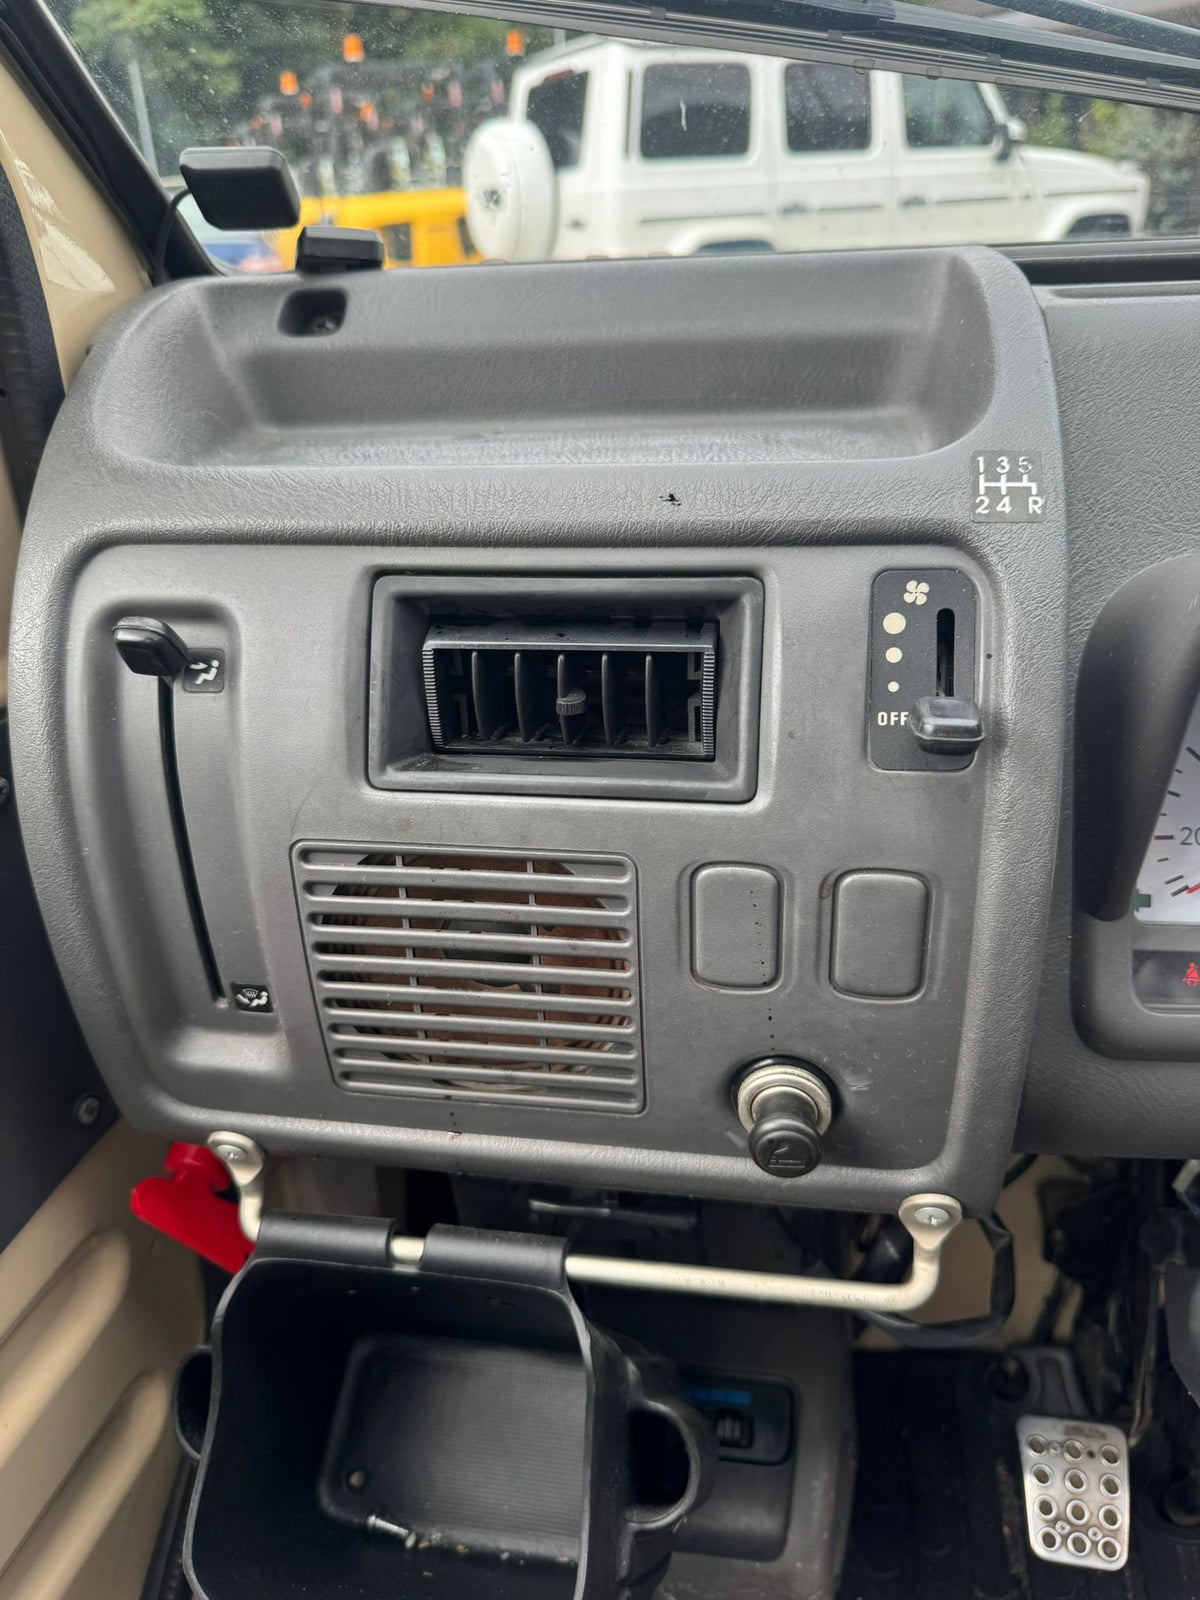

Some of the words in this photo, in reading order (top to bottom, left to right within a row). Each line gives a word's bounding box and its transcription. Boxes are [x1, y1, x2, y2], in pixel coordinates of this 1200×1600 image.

[977, 456, 985, 473] 1
[996, 456, 1010, 473] 3
[1018, 456, 1033, 473] 5
[975, 496, 990, 514] 2
[996, 496, 1012, 514] 4
[1028, 496, 1044, 514] R
[877, 711, 910, 726] OFF
